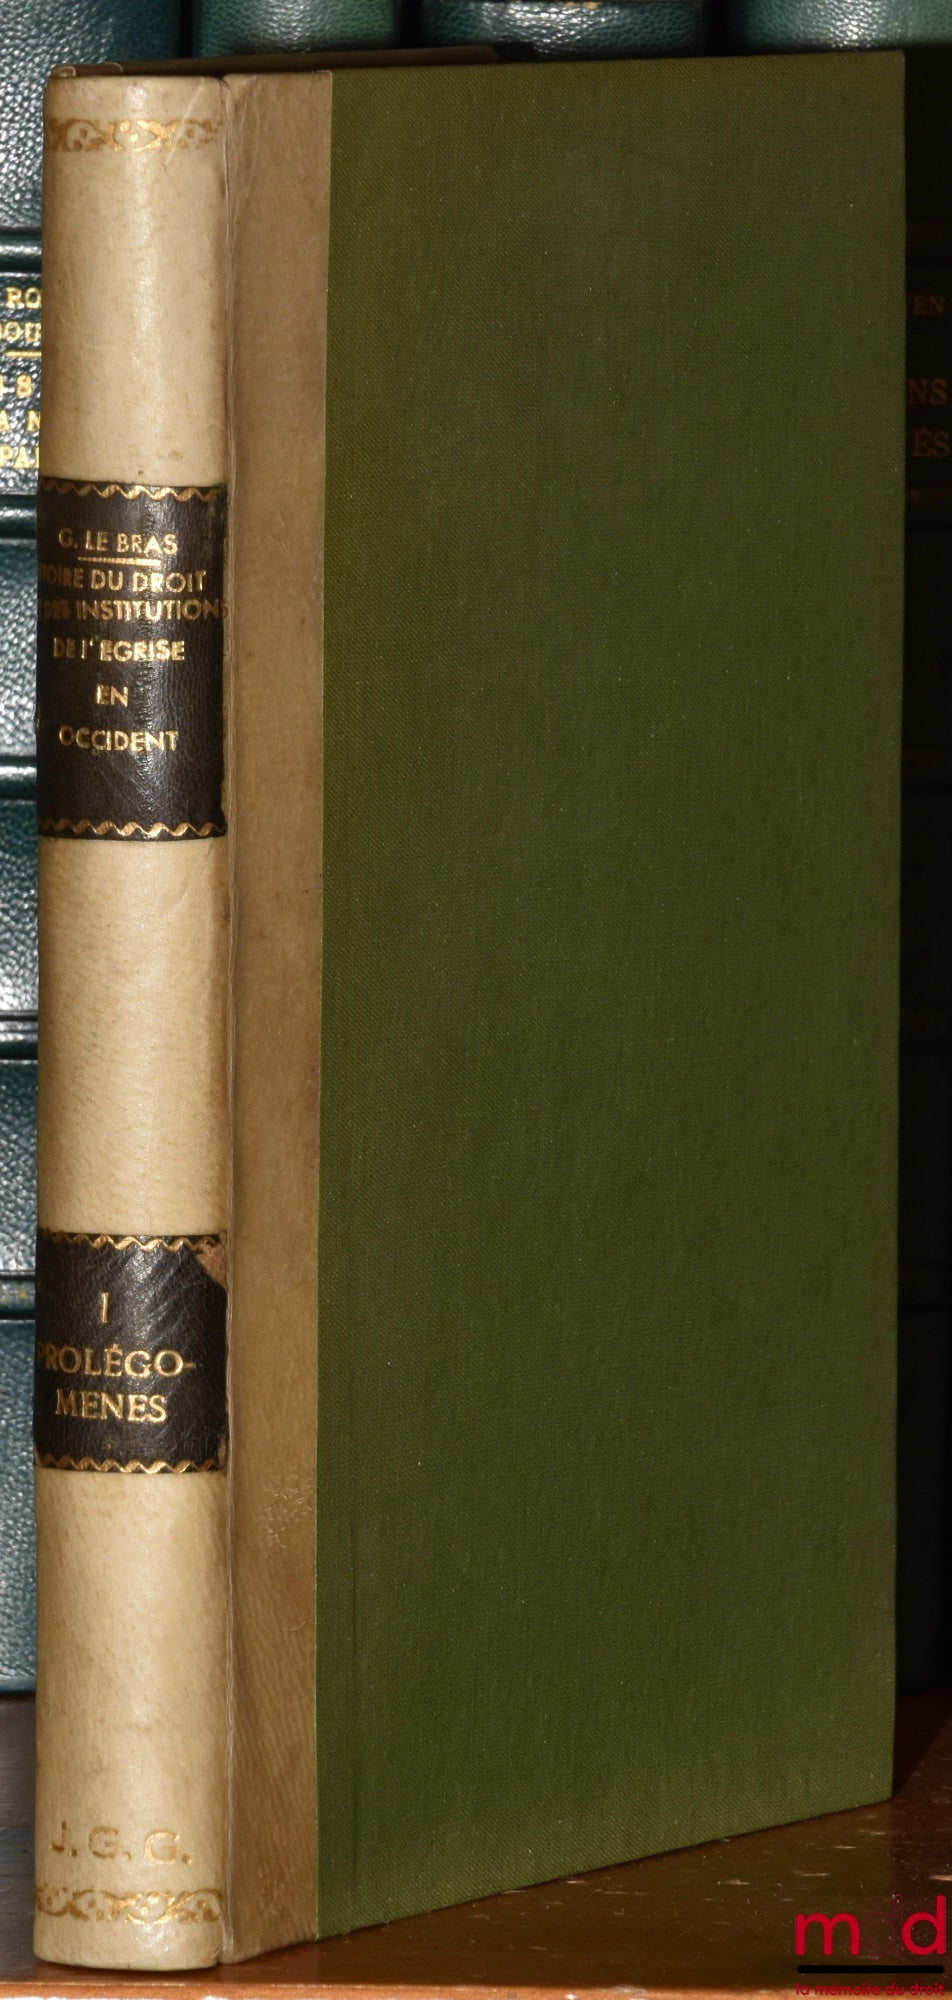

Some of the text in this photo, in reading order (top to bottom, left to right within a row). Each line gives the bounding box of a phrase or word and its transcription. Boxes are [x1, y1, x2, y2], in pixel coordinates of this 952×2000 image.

[0, 321, 41, 342] OU
[58, 528, 178, 554] G. LE BRAS
[90, 569, 124, 591] DU
[132, 570, 206, 593] DROIT
[53, 637, 76, 659] DE
[96, 684, 129, 707] EN
[58, 725, 179, 752] OCCIDENT
[55, 1389, 167, 1423] MENES
